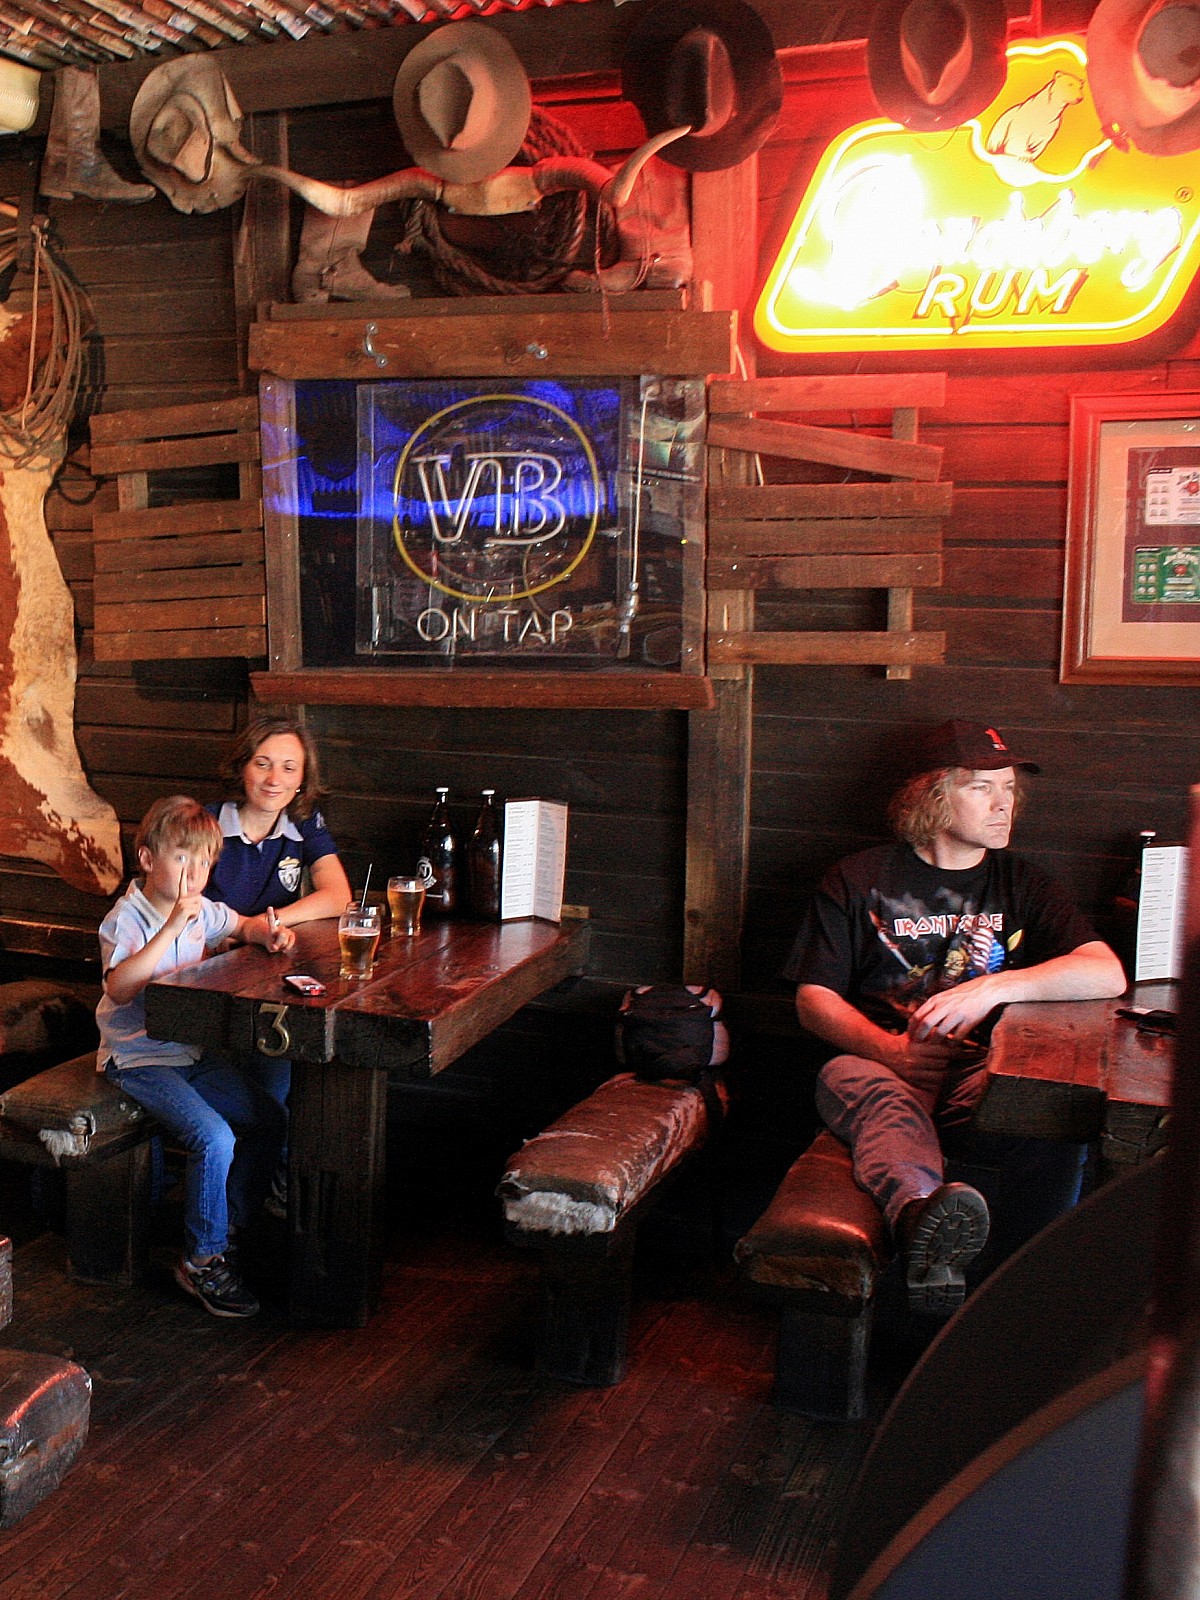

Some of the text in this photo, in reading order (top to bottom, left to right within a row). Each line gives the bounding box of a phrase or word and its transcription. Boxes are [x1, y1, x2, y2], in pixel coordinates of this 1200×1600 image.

[912, 267, 1088, 319] RUM
[410, 451, 567, 545] VB
[416, 608, 574, 644] ON TAP
[894, 914, 947, 940] IRON
[257, 1003, 288, 1057] 3
